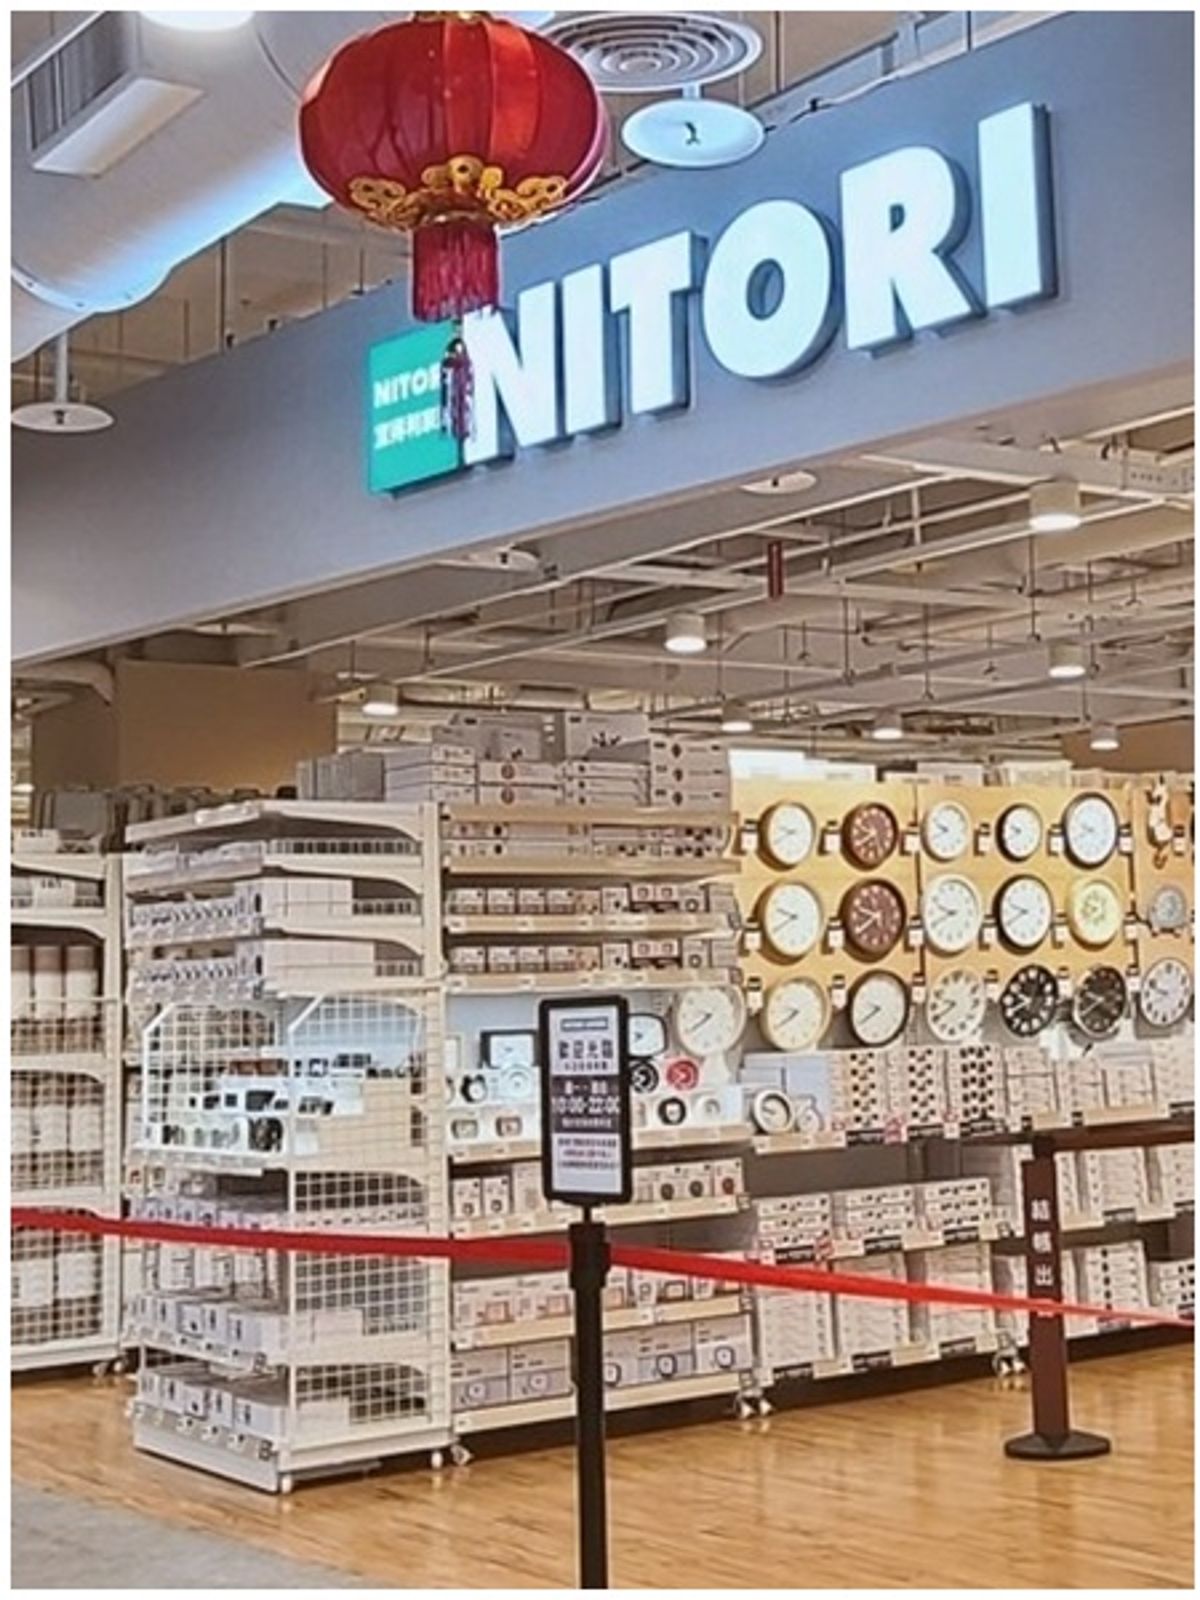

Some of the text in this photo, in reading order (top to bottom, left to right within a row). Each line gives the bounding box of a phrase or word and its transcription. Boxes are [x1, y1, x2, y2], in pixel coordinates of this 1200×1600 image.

[463, 102, 1042, 466] NITORI
[373, 362, 442, 409] NITOR
[1031, 1199, 1055, 1316] 結帳出
